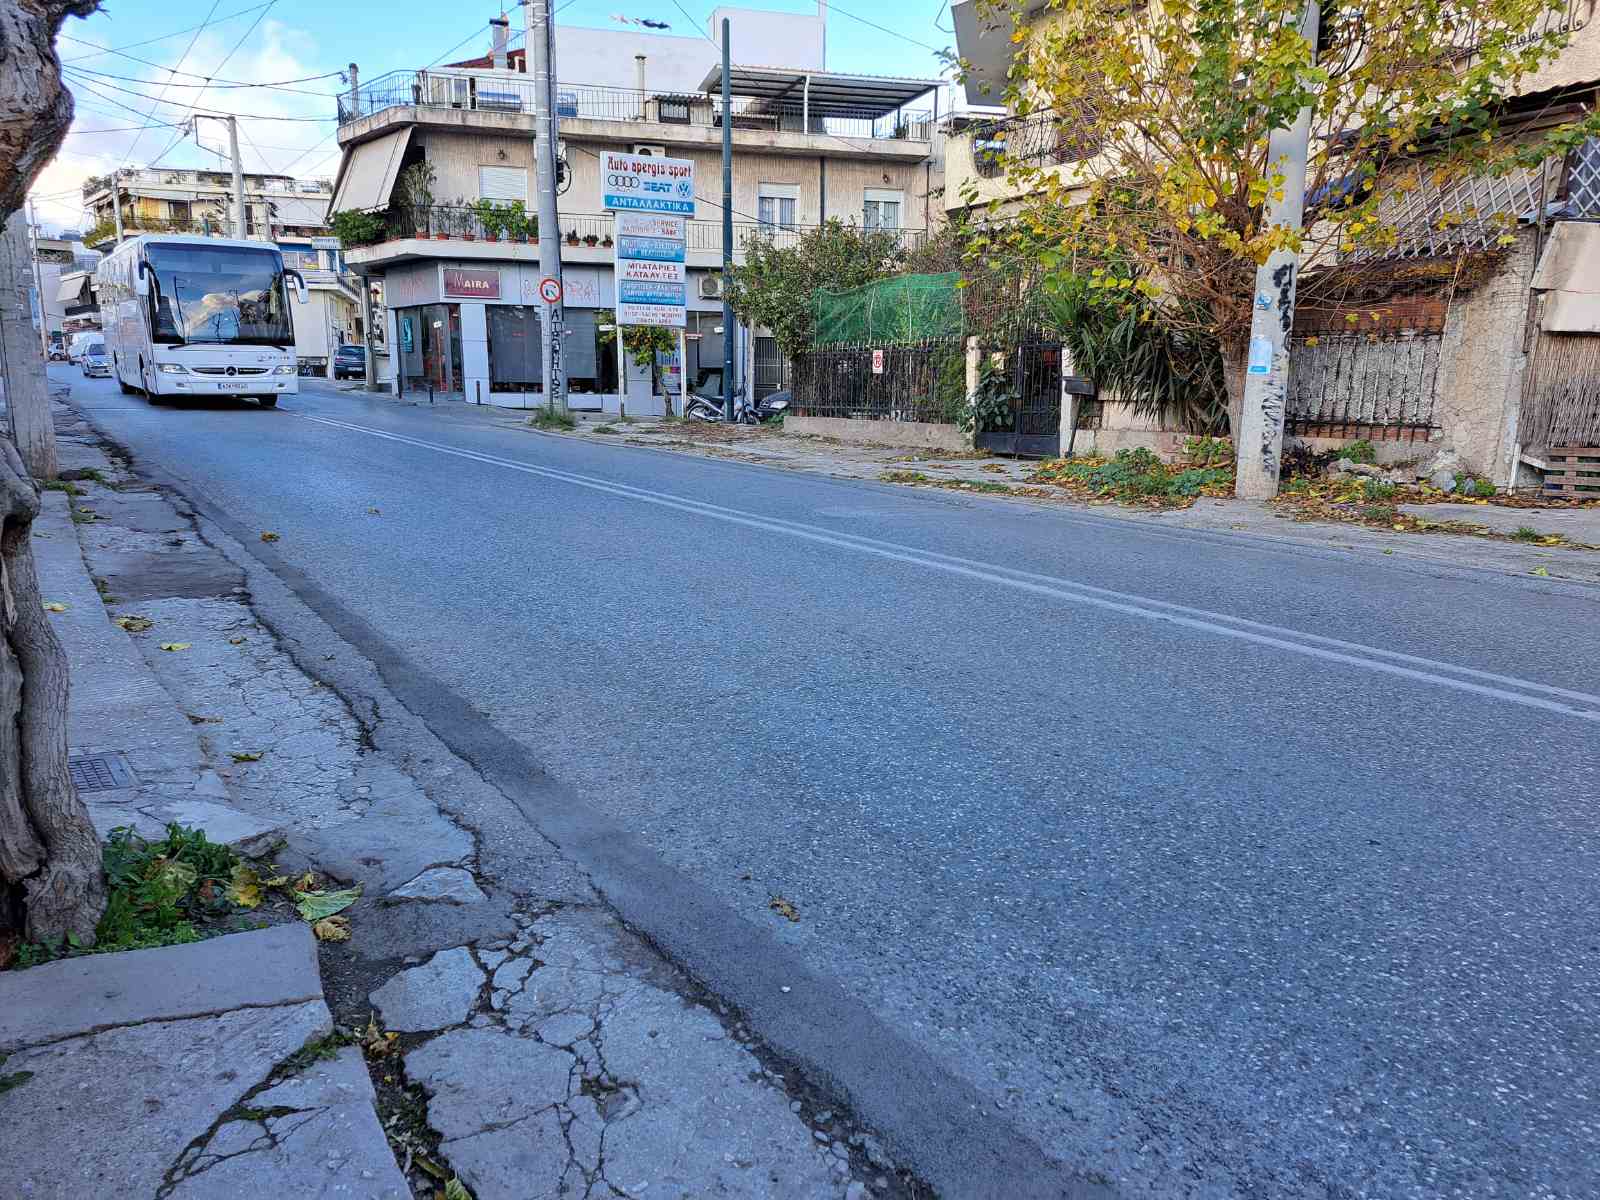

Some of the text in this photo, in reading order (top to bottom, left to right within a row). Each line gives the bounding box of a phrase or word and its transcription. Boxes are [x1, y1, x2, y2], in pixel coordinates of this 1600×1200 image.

[607, 155, 692, 180] Auto apergis sport
[643, 181, 673, 193] SEAT
[612, 197, 689, 211] ΑΝΤΑΛΛΑΚΤΙΚΑ
[627, 262, 677, 272] ΜΠΑΤΑΡΙΕΣ
